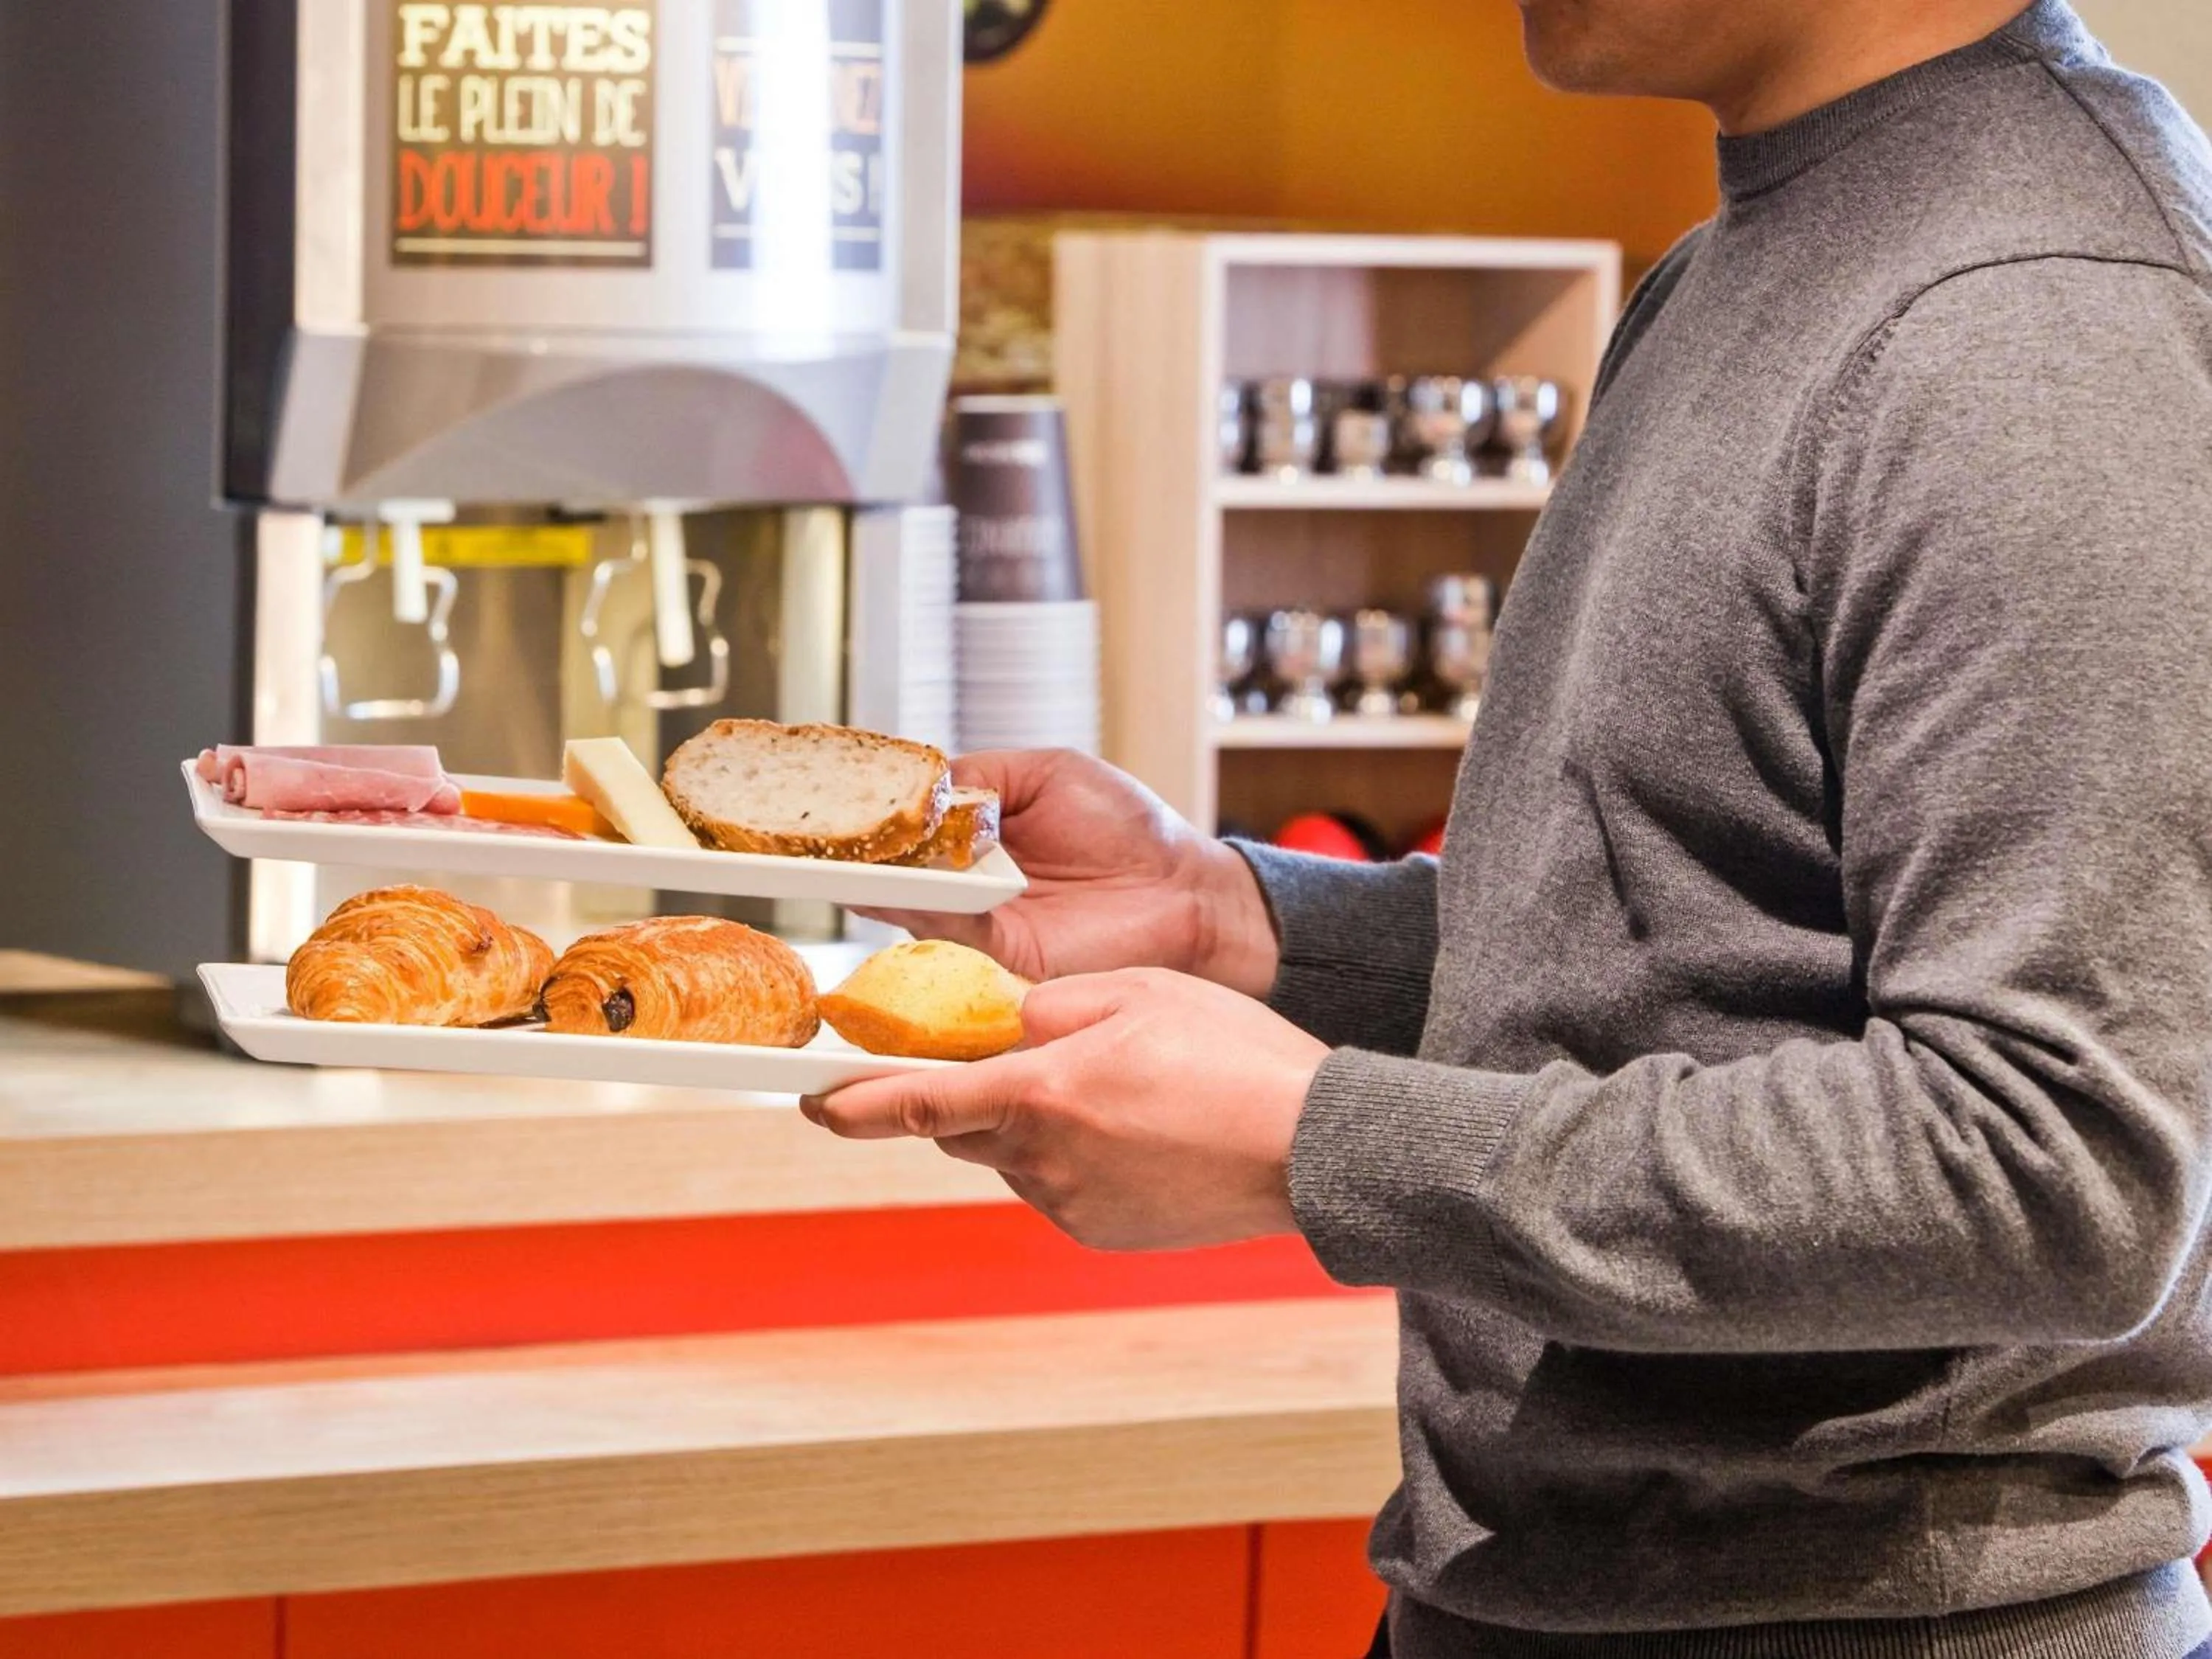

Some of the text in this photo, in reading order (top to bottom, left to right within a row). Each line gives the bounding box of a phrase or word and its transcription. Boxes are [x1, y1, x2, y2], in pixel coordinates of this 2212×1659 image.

[397, 4, 650, 72] FAITES
[398, 74, 450, 142] LE
[460, 75, 581, 145] PLEIN
[592, 78, 647, 147] DE
